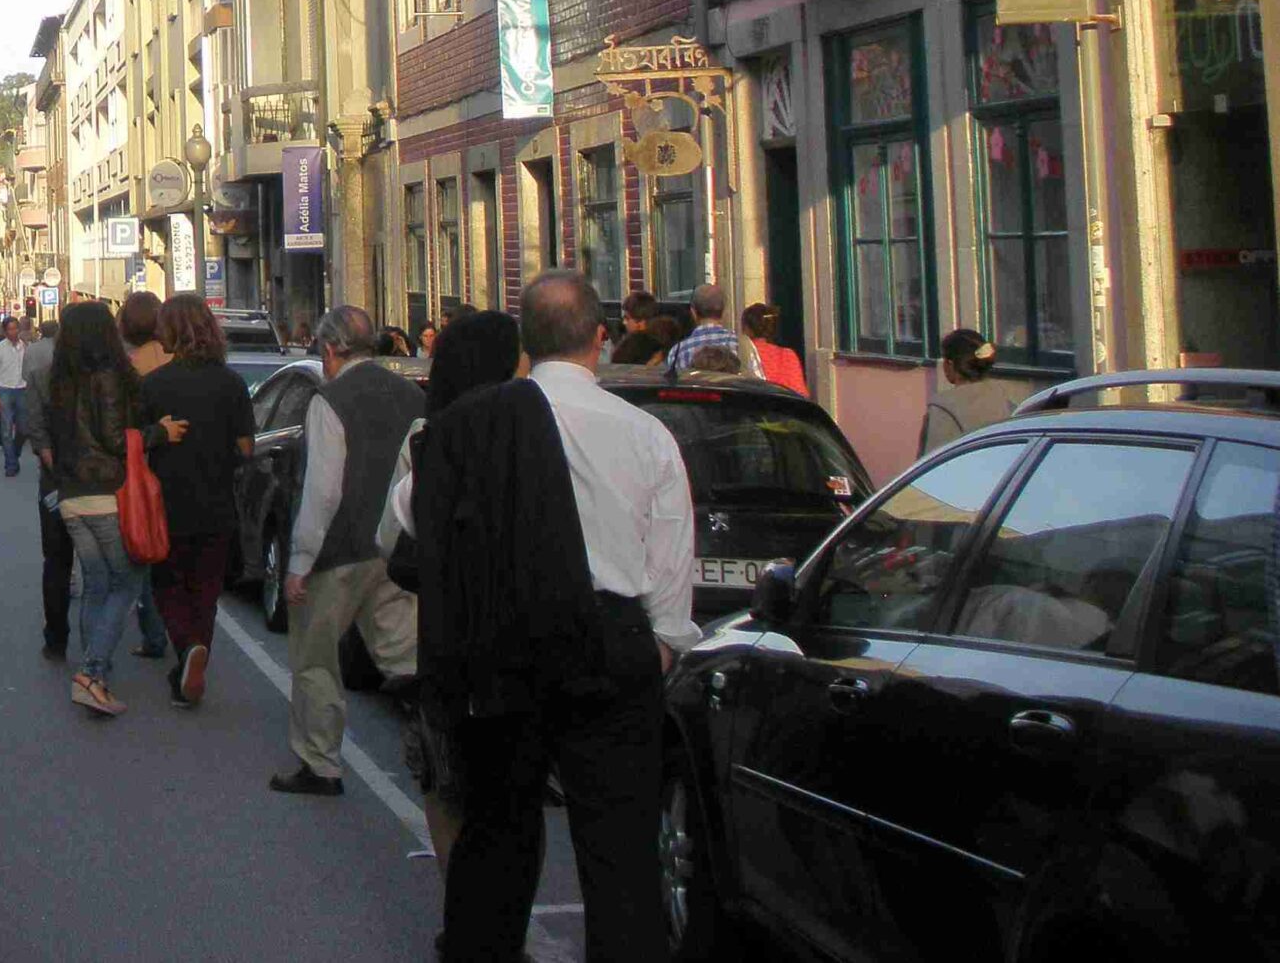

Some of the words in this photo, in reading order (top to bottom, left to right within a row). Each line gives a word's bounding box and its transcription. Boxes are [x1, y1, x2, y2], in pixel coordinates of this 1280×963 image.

[298, 157, 310, 194] Matos
[299, 195, 310, 233] Adélia
[115, 224, 131, 244] P
[172, 221, 182, 255] KONG
[173, 256, 182, 282] KING
[206, 261, 219, 279] P
